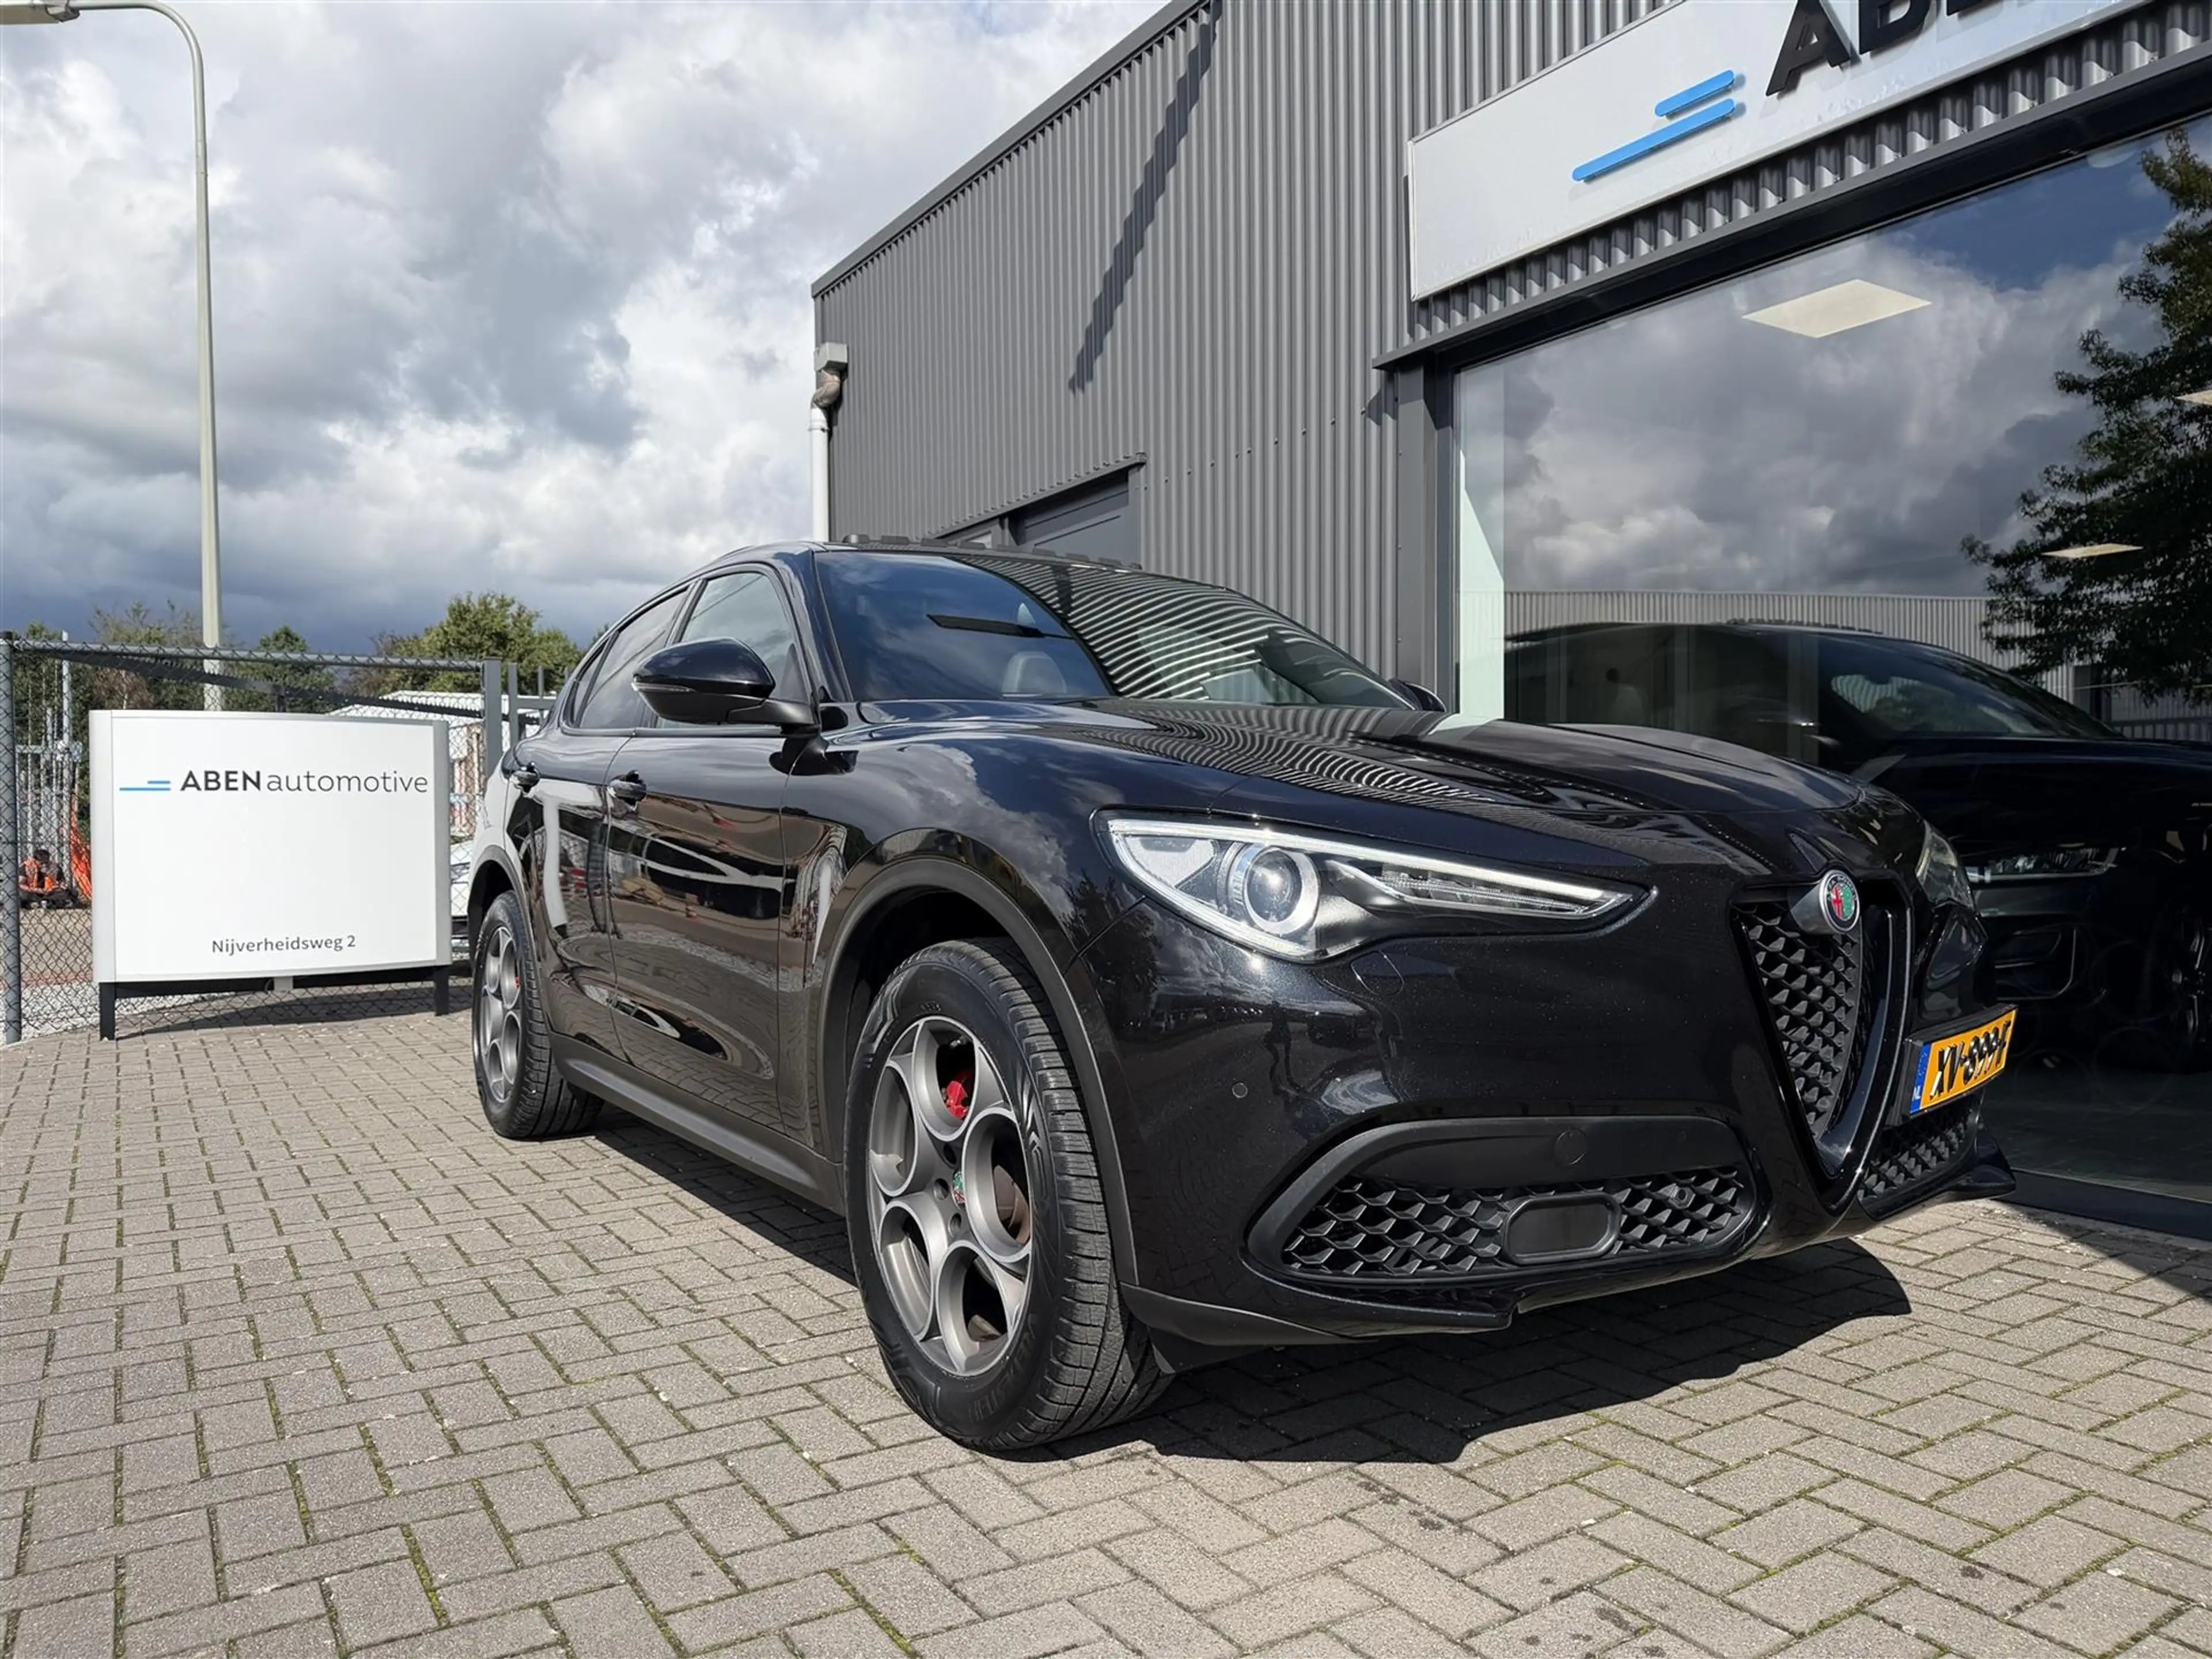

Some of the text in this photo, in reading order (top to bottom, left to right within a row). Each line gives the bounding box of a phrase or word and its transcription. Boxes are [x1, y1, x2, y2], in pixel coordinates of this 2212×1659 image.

[1766, 0, 1983, 96] AB
[211, 934, 356, 956] Nijverheidsweg 2
